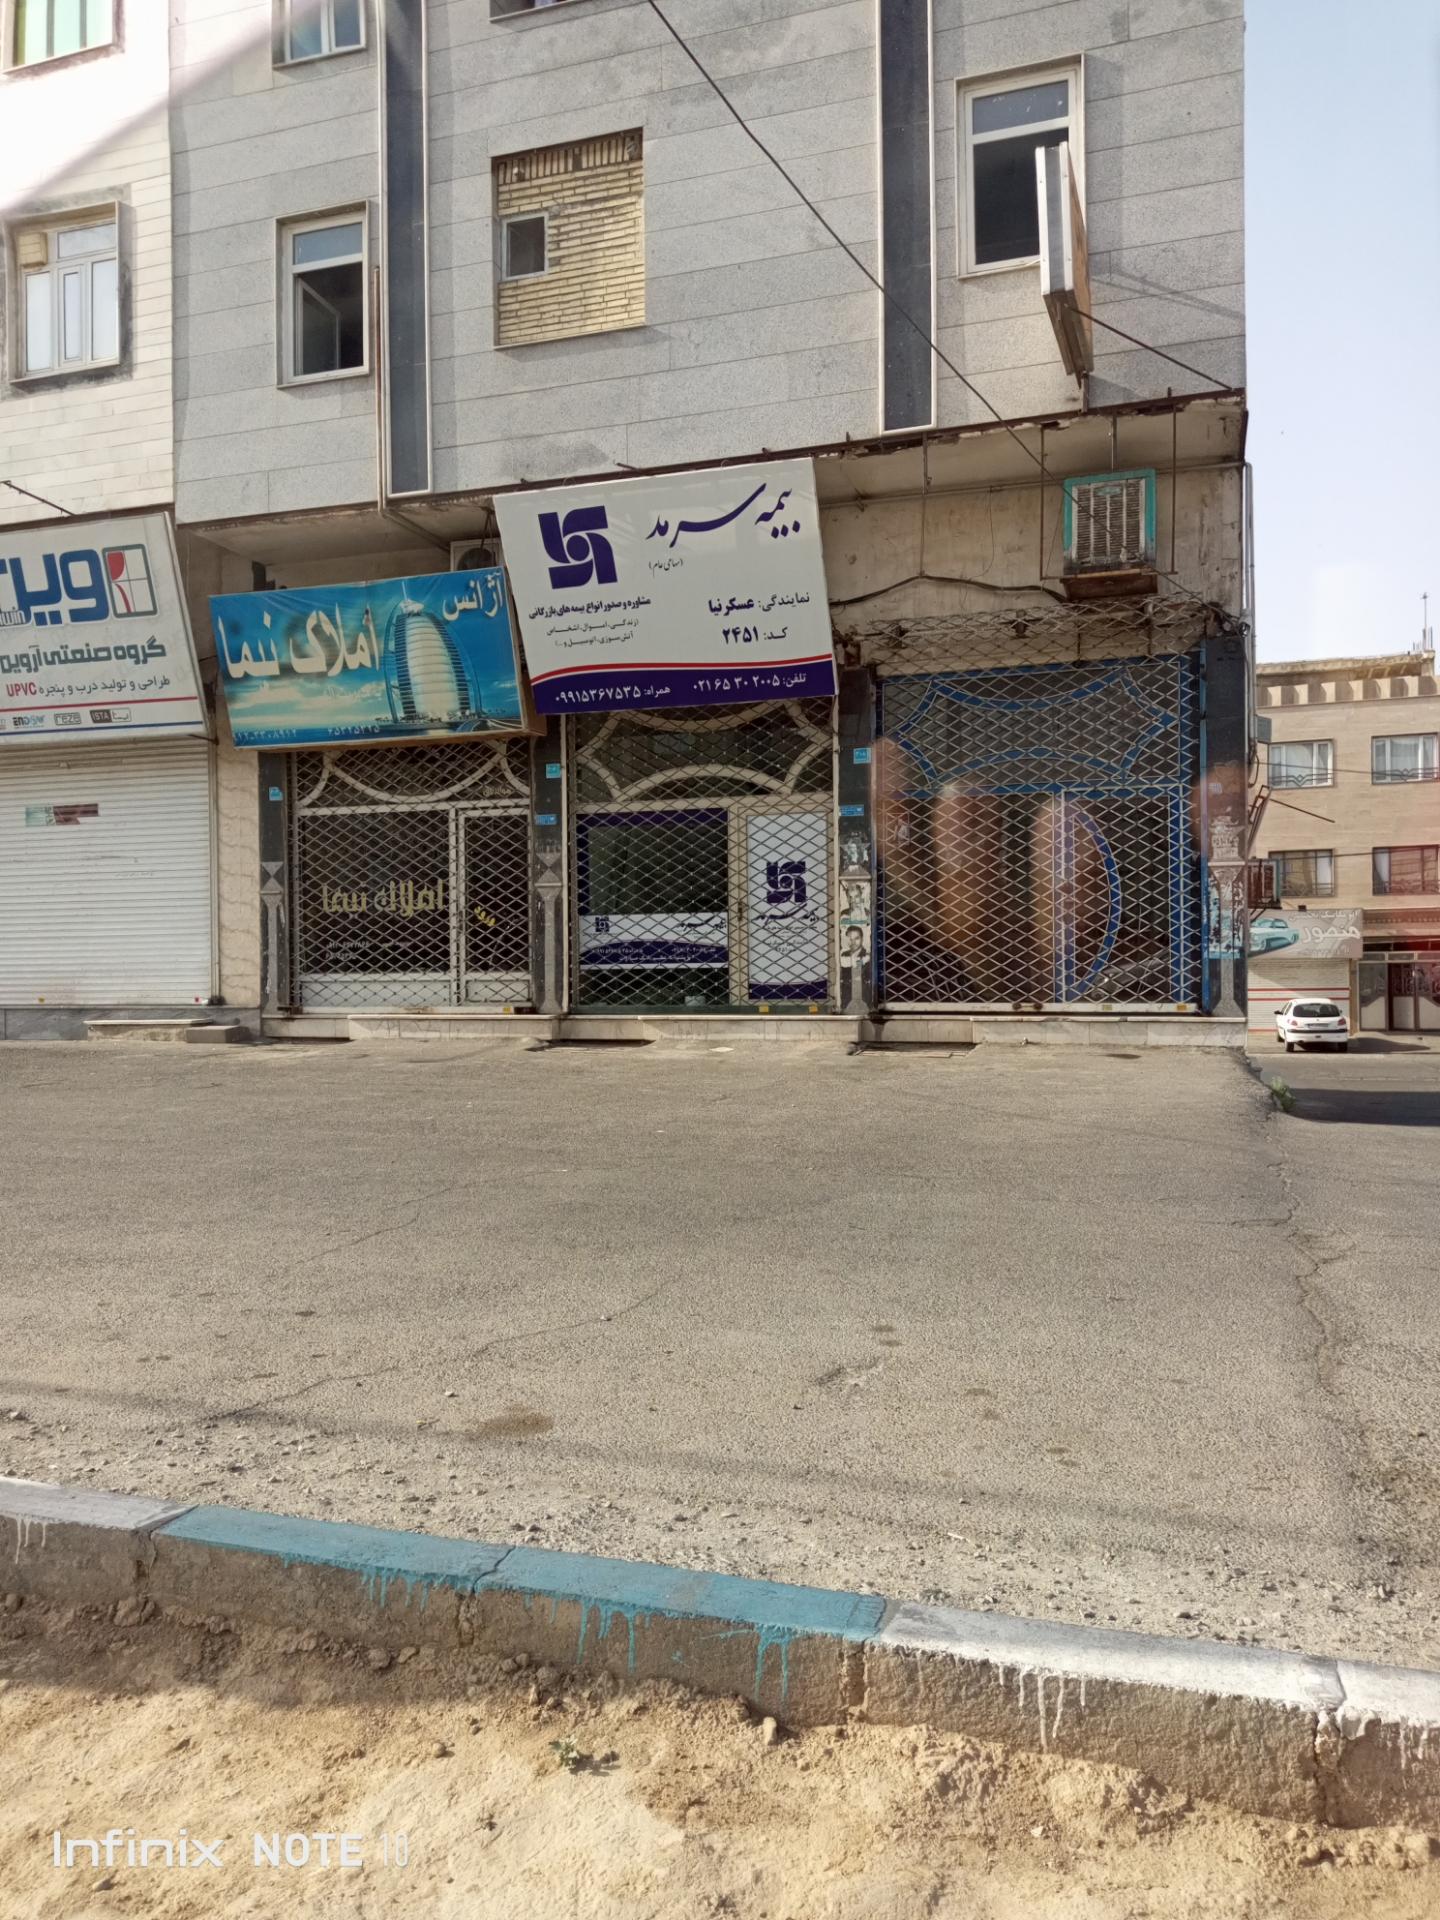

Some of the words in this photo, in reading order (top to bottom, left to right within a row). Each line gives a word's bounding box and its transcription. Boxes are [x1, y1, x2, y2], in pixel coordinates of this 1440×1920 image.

[645, 482, 767, 548] سرمد
[754, 488, 800, 539] بیمه
[443, 572, 504, 620] آژانس
[758, 591, 810, 612] نمایندگی:
[290, 602, 380, 678] املاک
[722, 625, 759, 645] ۲۴۵۱
[44, 642, 112, 666] صنعتی
[114, 635, 167, 665] گروه
[6, 681, 38, 698] UPVC
[39, 684, 66, 698] پنجره
[75, 682, 98, 695] درب
[101, 678, 127, 693] تولید
[129, 681, 136, 692] و
[138, 675, 170, 692] طراحی
[1301, 925, 1361, 943] منصور
